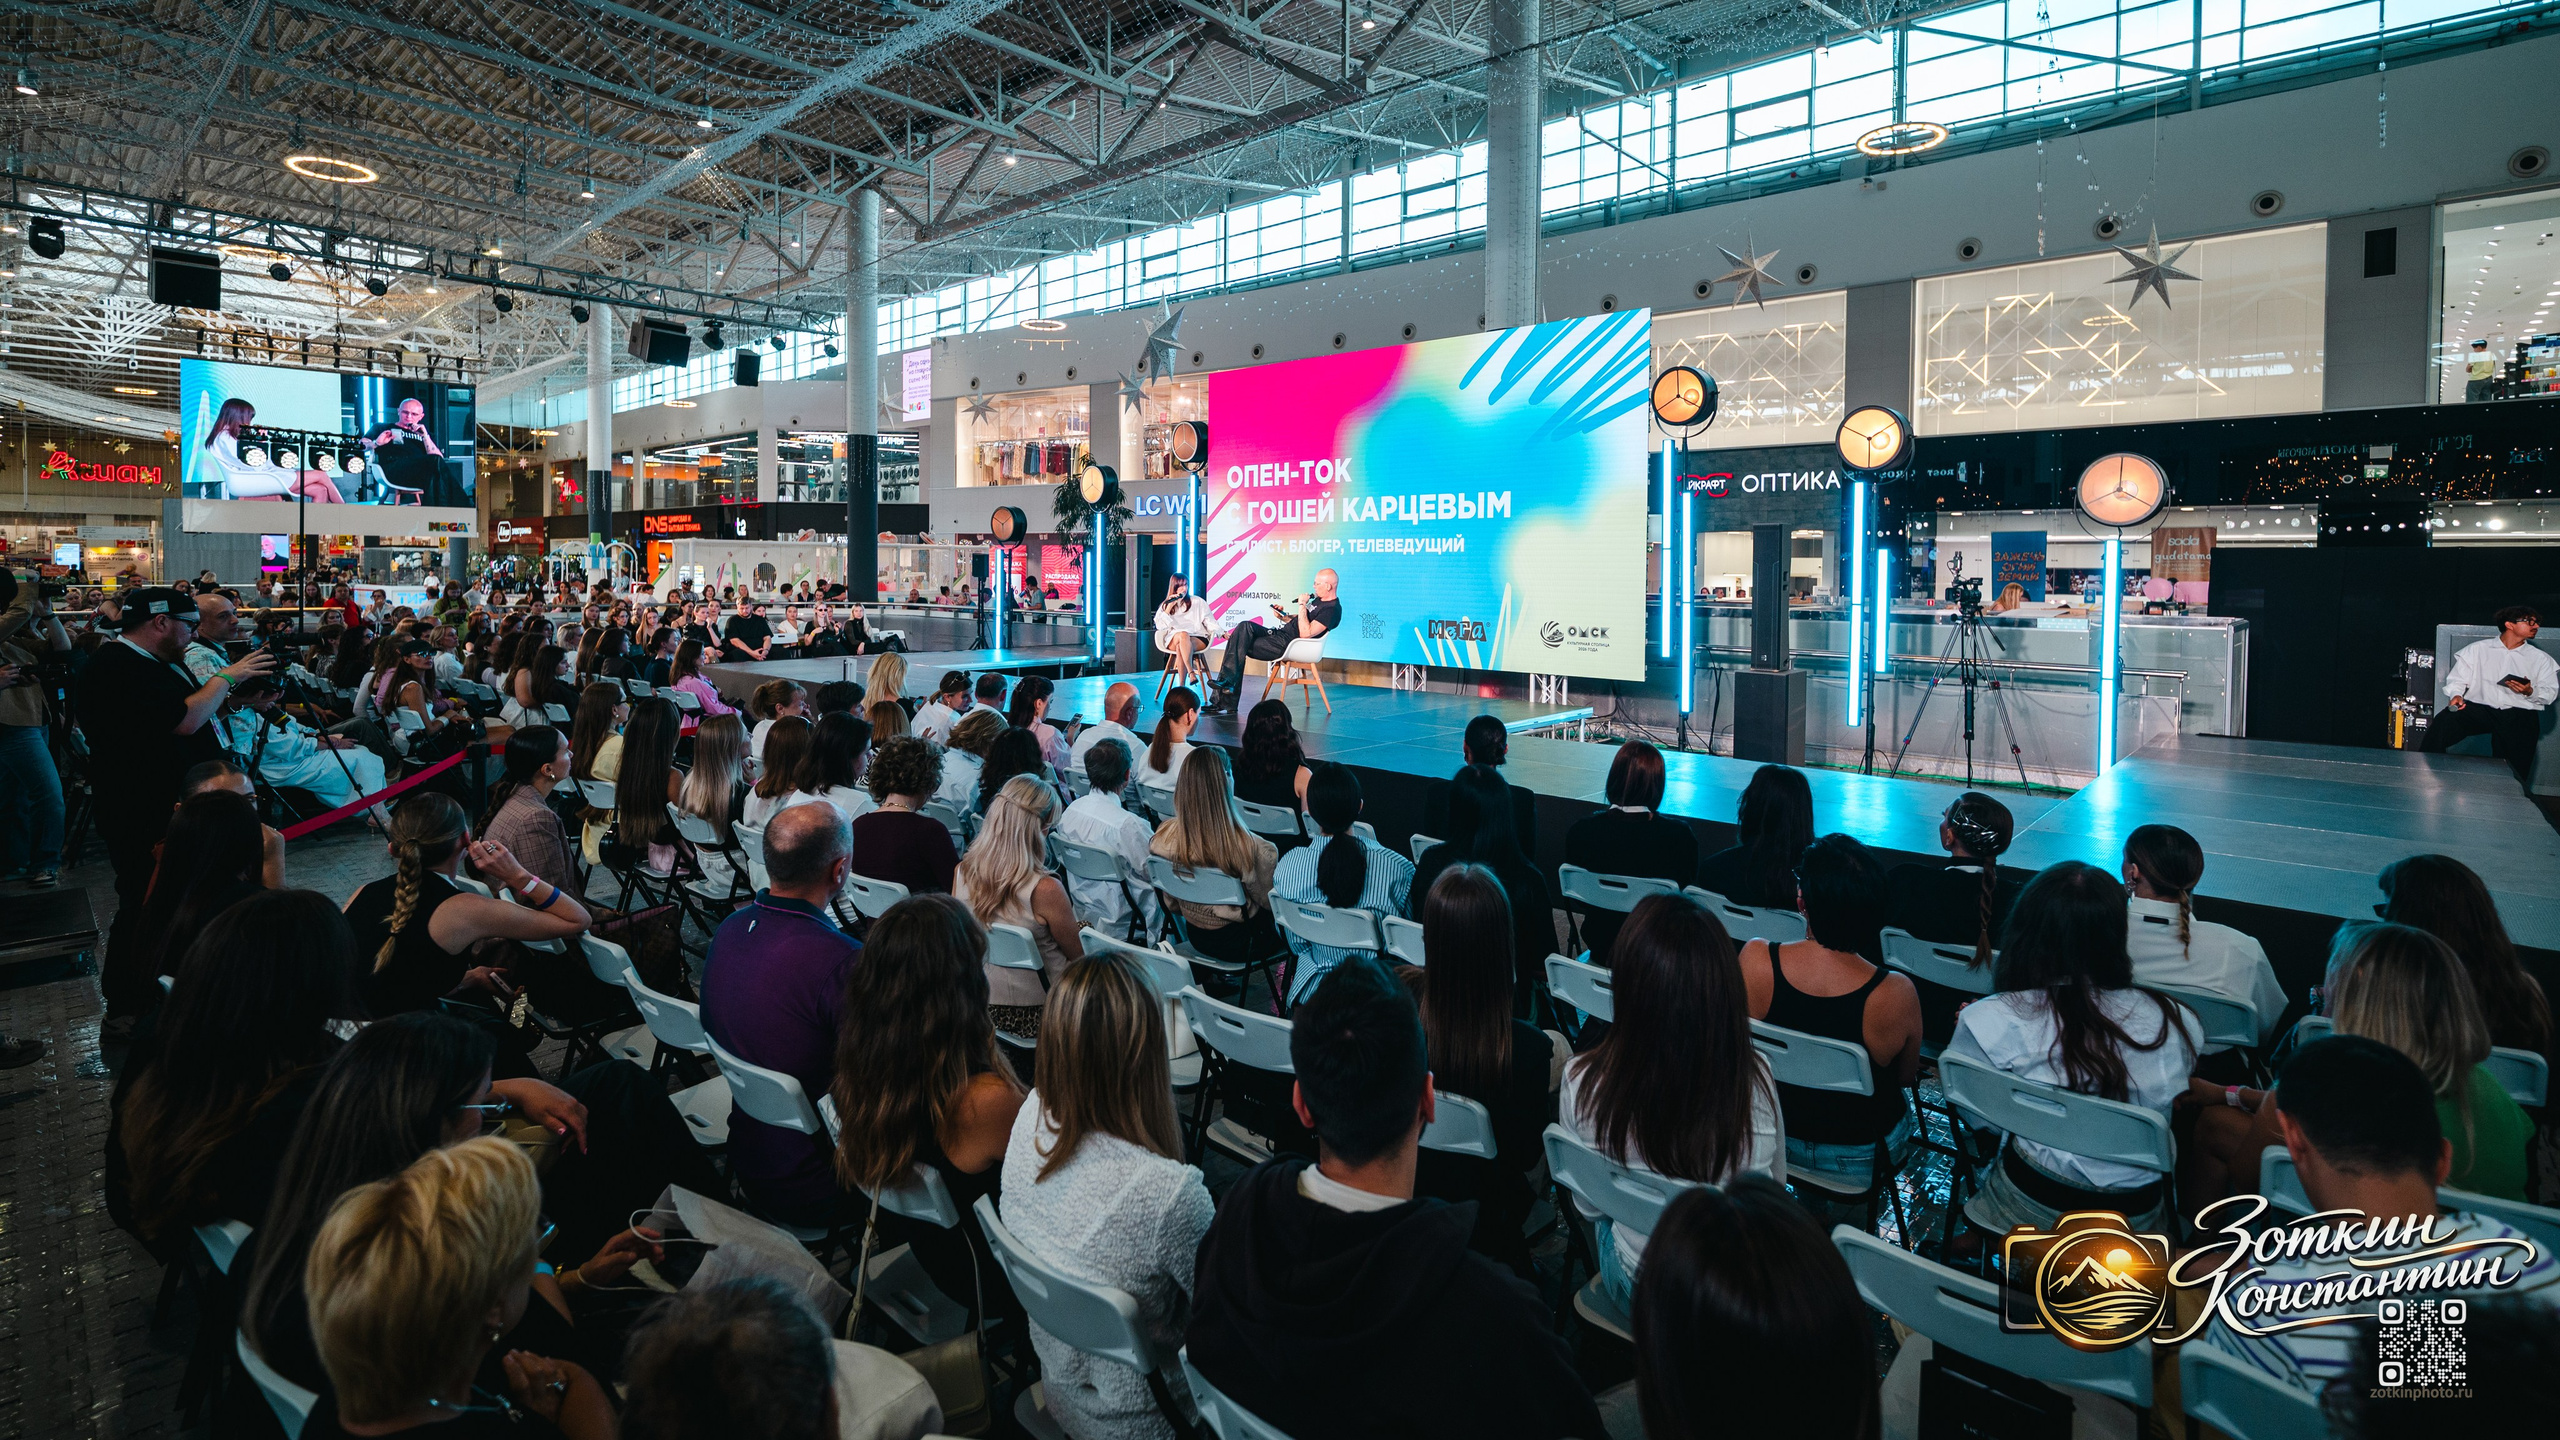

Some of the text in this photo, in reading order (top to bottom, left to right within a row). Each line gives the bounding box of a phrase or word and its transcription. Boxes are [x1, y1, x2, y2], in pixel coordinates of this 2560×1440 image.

[1226, 457, 1352, 489] ОПЕН-ТОК
[1686, 478, 1727, 491] ЙКРАФТ
[1741, 470, 1841, 493] ОПТИКА
[1135, 494, 1161, 516] LC
[1226, 490, 1512, 526] С ГОШЕЙ КАРЦЕВЫМ
[644, 515, 668, 534] DNS
[1289, 539, 1344, 555] БЛОГЕР,
[1348, 533, 1465, 555] ТЕЛЕВЕДУЩИЙ
[2168, 535, 2200, 546] soda
[1226, 591, 1281, 600] ОРГАНИЗАТОРЫ:
[1567, 625, 1611, 640] ОМСК
